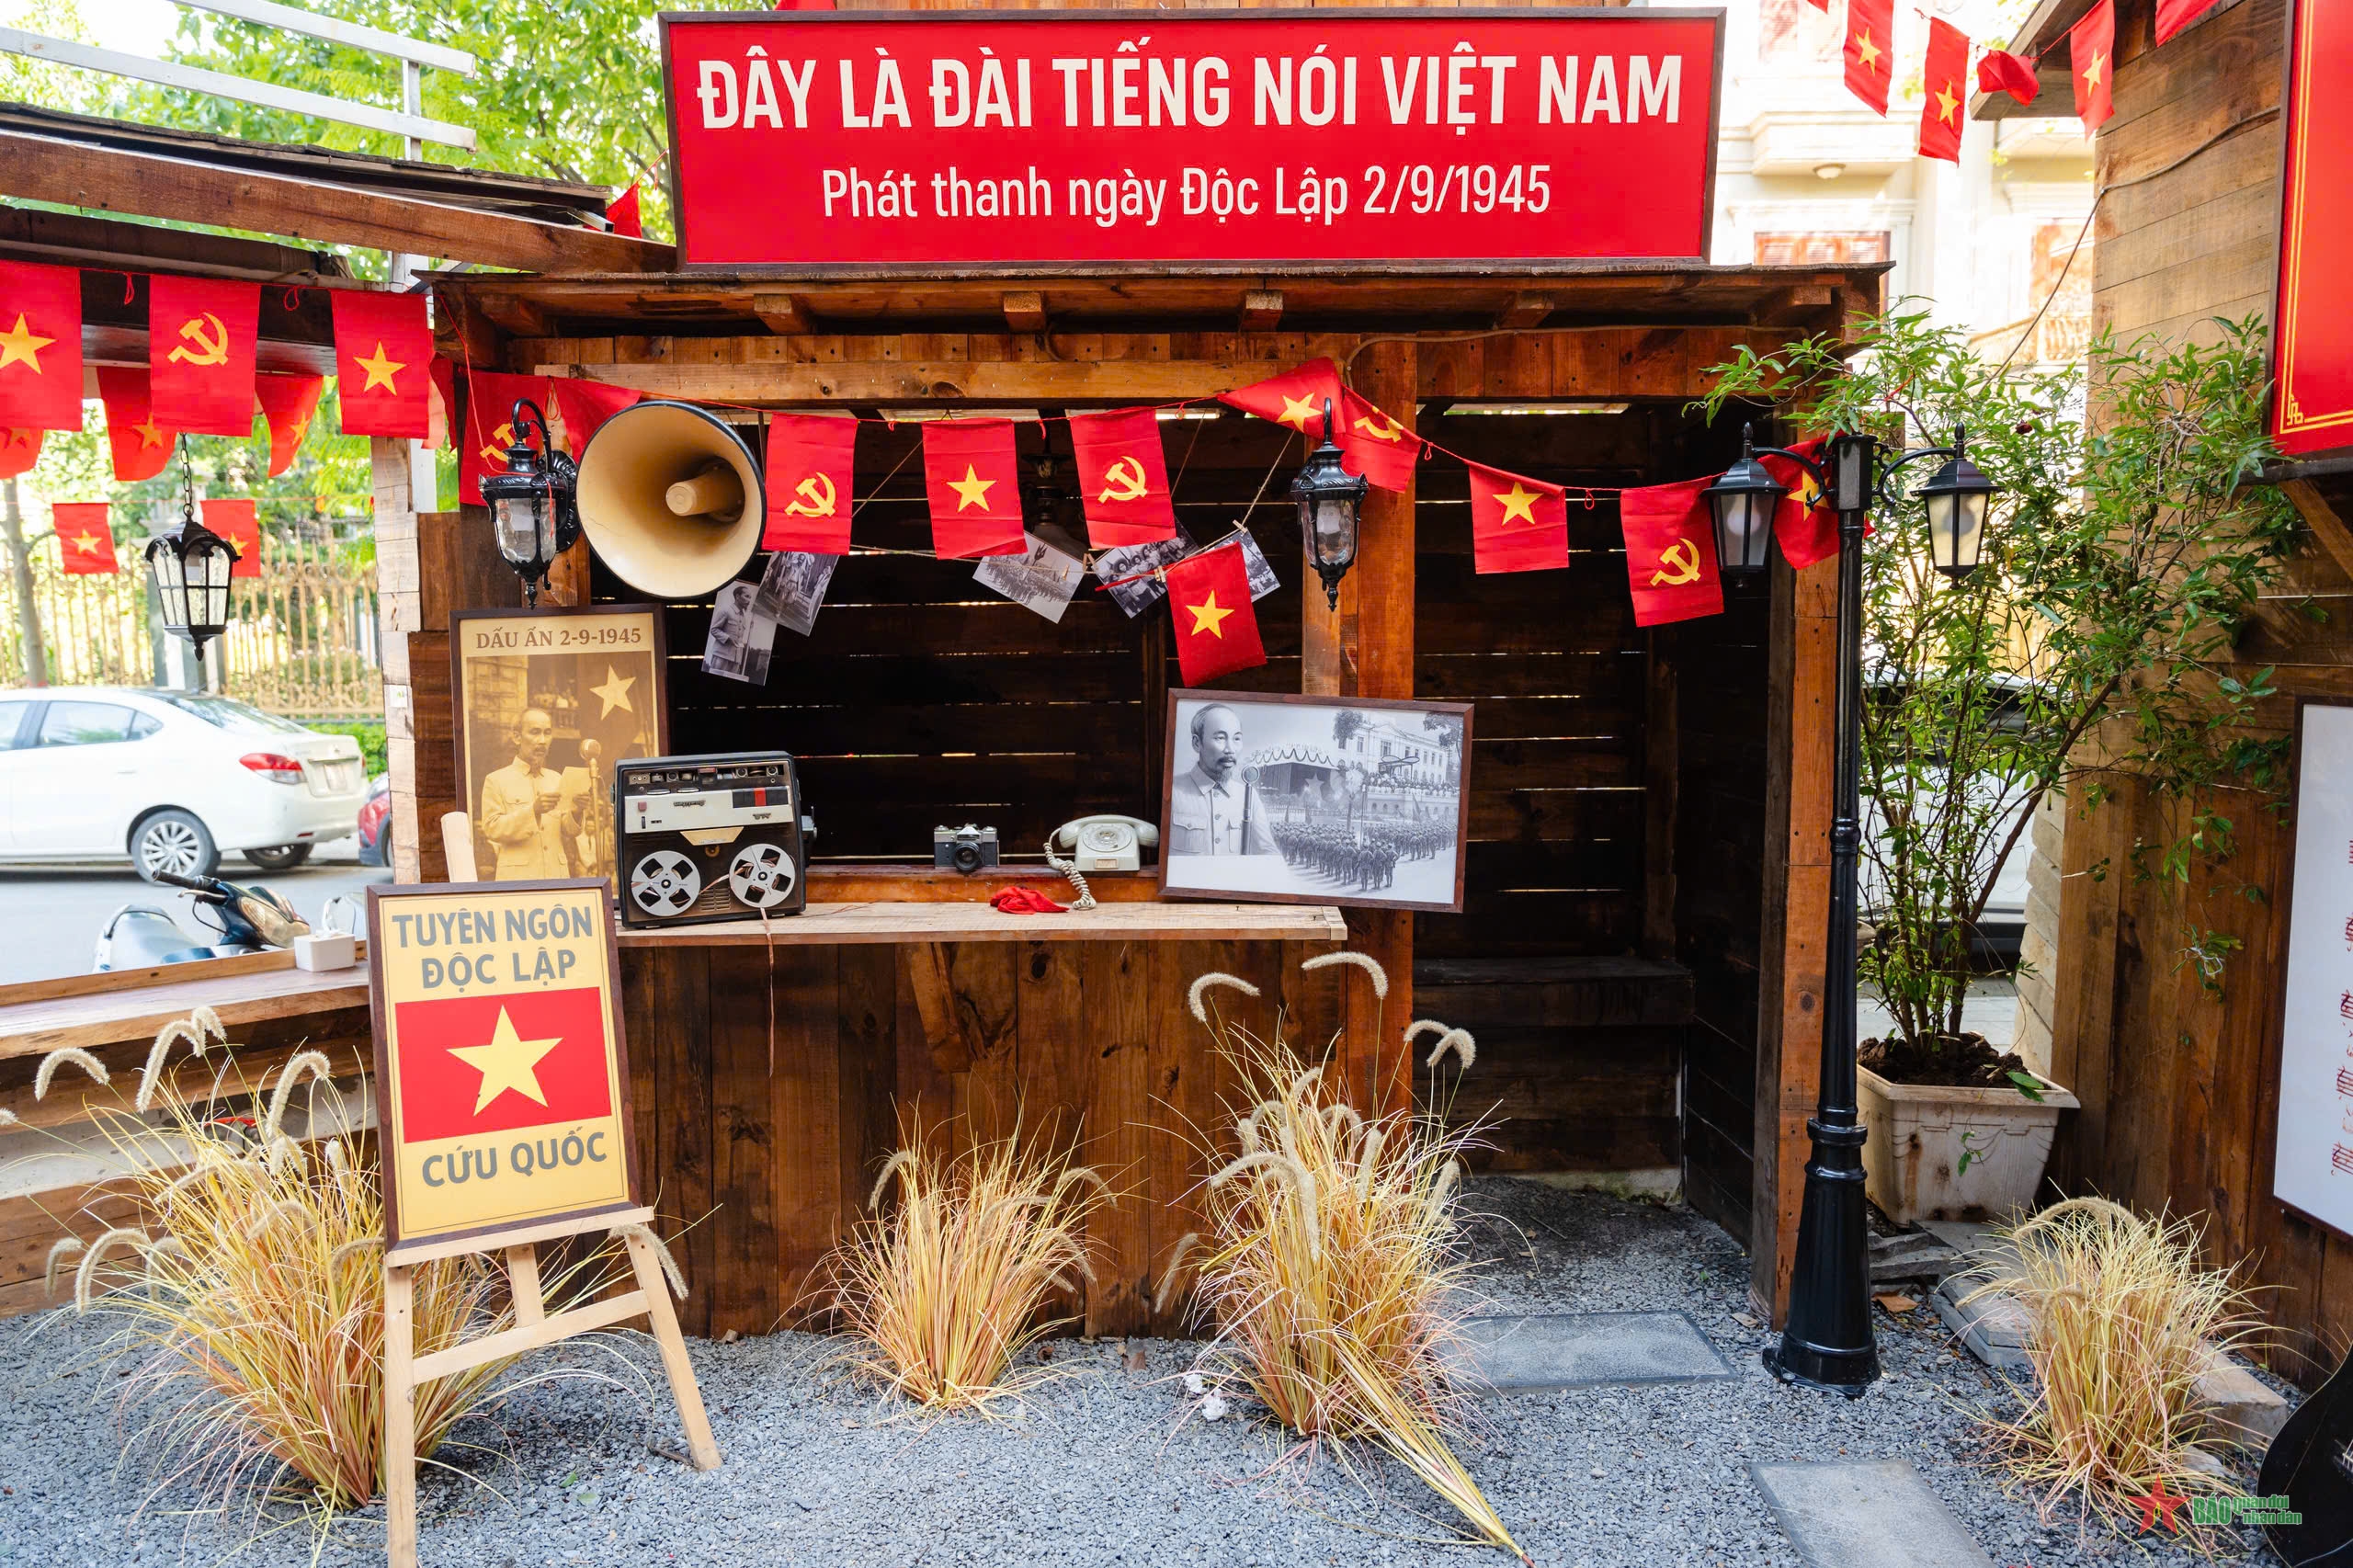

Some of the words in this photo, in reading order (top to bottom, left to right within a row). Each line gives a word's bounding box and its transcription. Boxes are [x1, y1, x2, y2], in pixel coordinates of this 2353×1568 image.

[697, 46, 816, 128] ĐÂY
[840, 48, 911, 127] LÀ
[929, 47, 1031, 127] ĐÀI
[1052, 37, 1229, 126] TIẾNG
[1255, 44, 1357, 125] NÓI
[1381, 42, 1517, 135] VIỆT
[1539, 56, 1681, 123] NAM
[824, 167, 917, 217] Phát
[931, 166, 1051, 216] thanh
[1070, 169, 1166, 227] ngày
[1180, 168, 1258, 222] Độc
[1277, 167, 1347, 225] Lập
[1364, 165, 1550, 213] 2/9/1945
[476, 626, 518, 649] DẤU
[525, 626, 553, 648] ẤN
[560, 628, 642, 646] 2-9-1945
[392, 907, 496, 948] TUYÊN
[505, 903, 593, 942] NGÔN
[421, 951, 497, 993] ĐỘC
[512, 947, 576, 986] LẬP
[422, 1144, 498, 1187] CỨU
[510, 1126, 608, 1177] QUỐC
